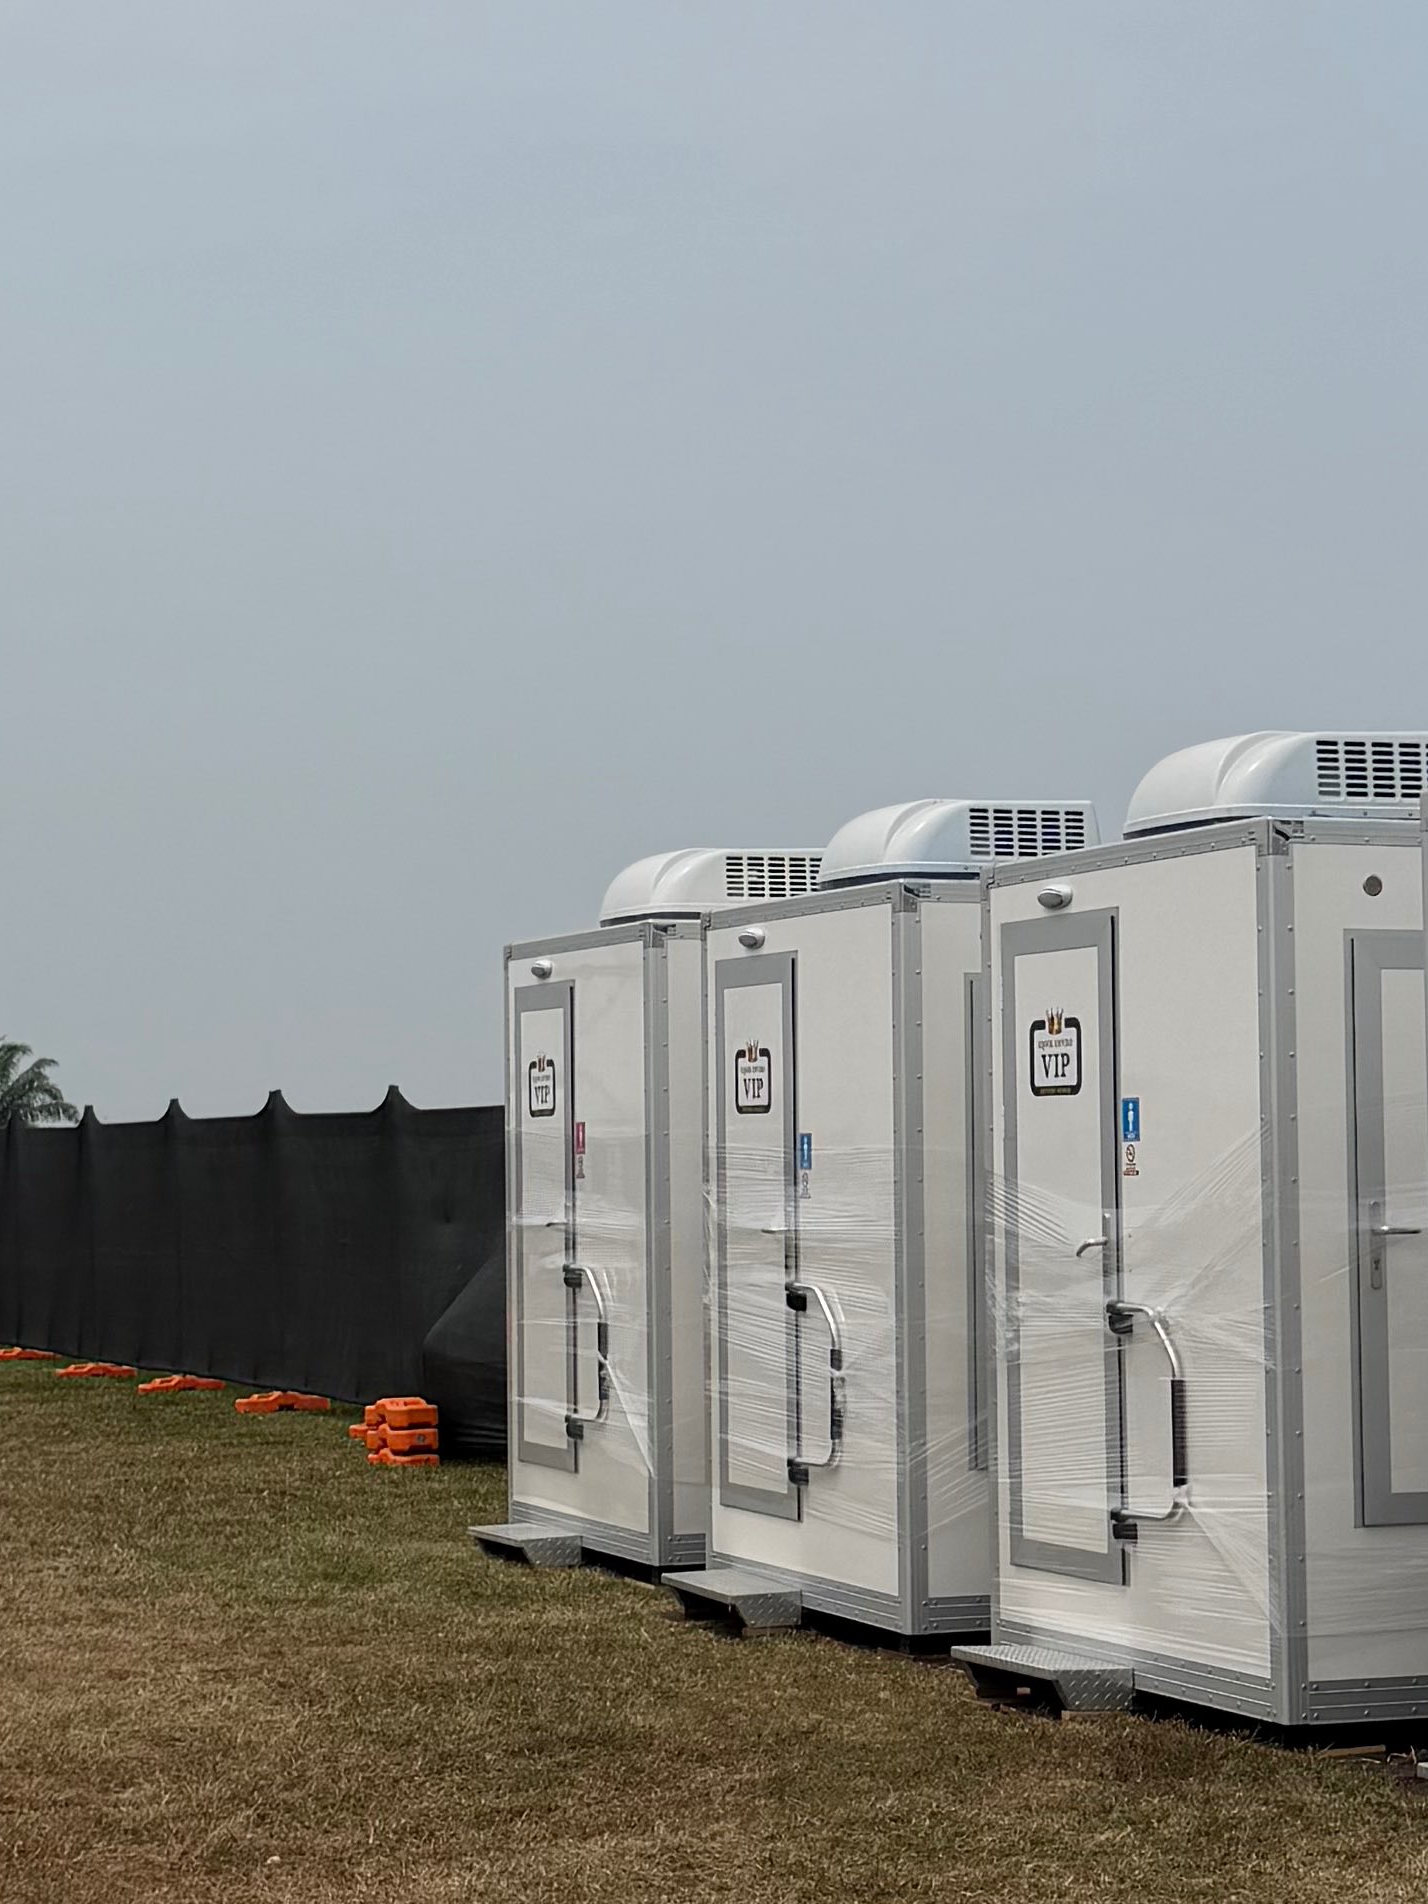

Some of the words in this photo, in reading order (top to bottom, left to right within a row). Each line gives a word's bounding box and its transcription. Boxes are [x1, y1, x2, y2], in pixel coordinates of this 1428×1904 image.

[1041, 1052, 1070, 1079] VIP
[534, 1084, 551, 1105] VIP
[743, 1077, 764, 1100] VIP
